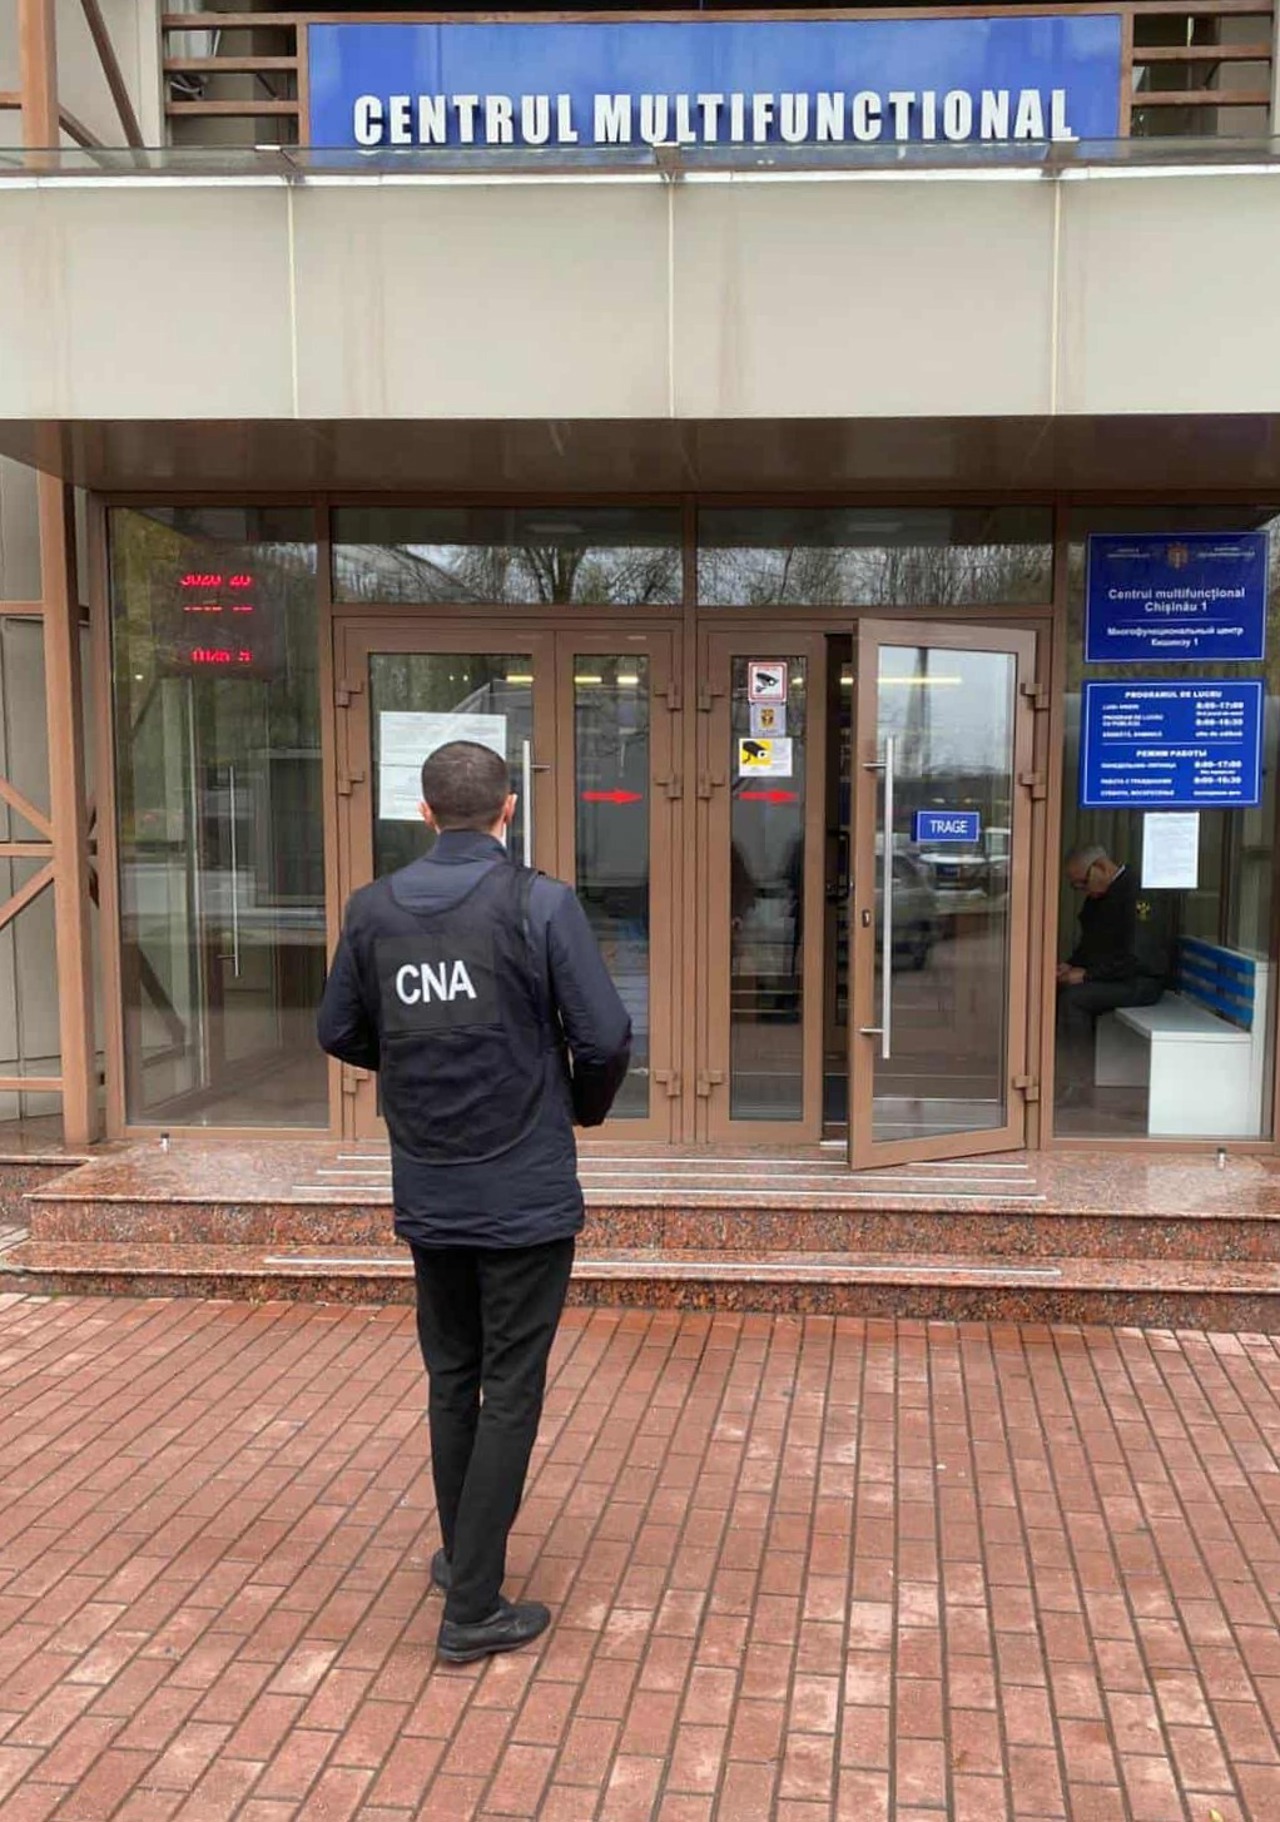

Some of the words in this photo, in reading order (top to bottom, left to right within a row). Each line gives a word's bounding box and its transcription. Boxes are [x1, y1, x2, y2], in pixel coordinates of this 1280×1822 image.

[353, 94, 578, 145] CENTRUL
[594, 89, 1074, 144] MULTIFUNCTIONAL
[1108, 588, 1152, 599] Centrul
[1201, 600, 1207, 611] 1
[930, 819, 968, 834] TRAGE
[395, 959, 478, 1005] CNA
